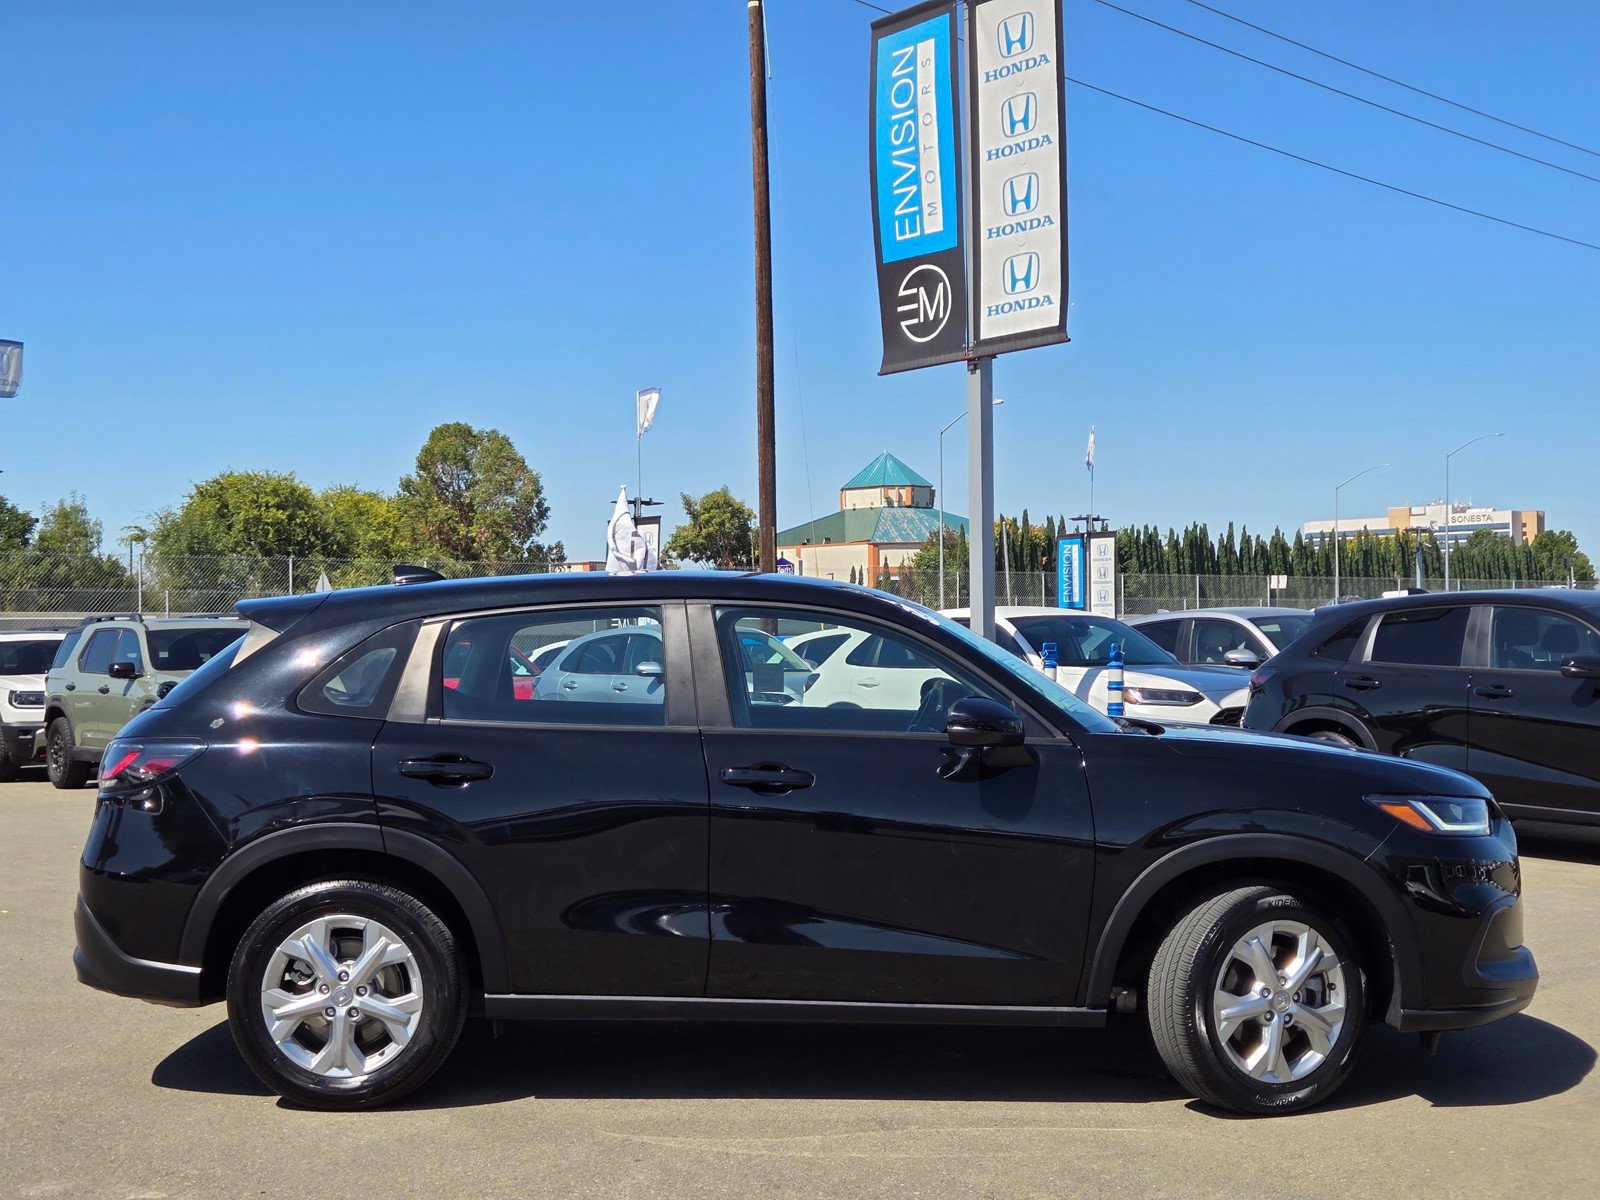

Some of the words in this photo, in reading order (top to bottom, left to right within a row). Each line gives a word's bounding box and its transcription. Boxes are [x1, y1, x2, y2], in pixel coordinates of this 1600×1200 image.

[984, 53, 1052, 84] HONDA
[891, 45, 921, 241] ENVISION
[921, 57, 938, 217] MOTORS
[986, 133, 1054, 162] HONDA
[986, 214, 1055, 240] HONDA
[986, 293, 1055, 318] HONDA
[1451, 514, 1492, 523] SONESTA
[1063, 544, 1072, 603] ENVISION
